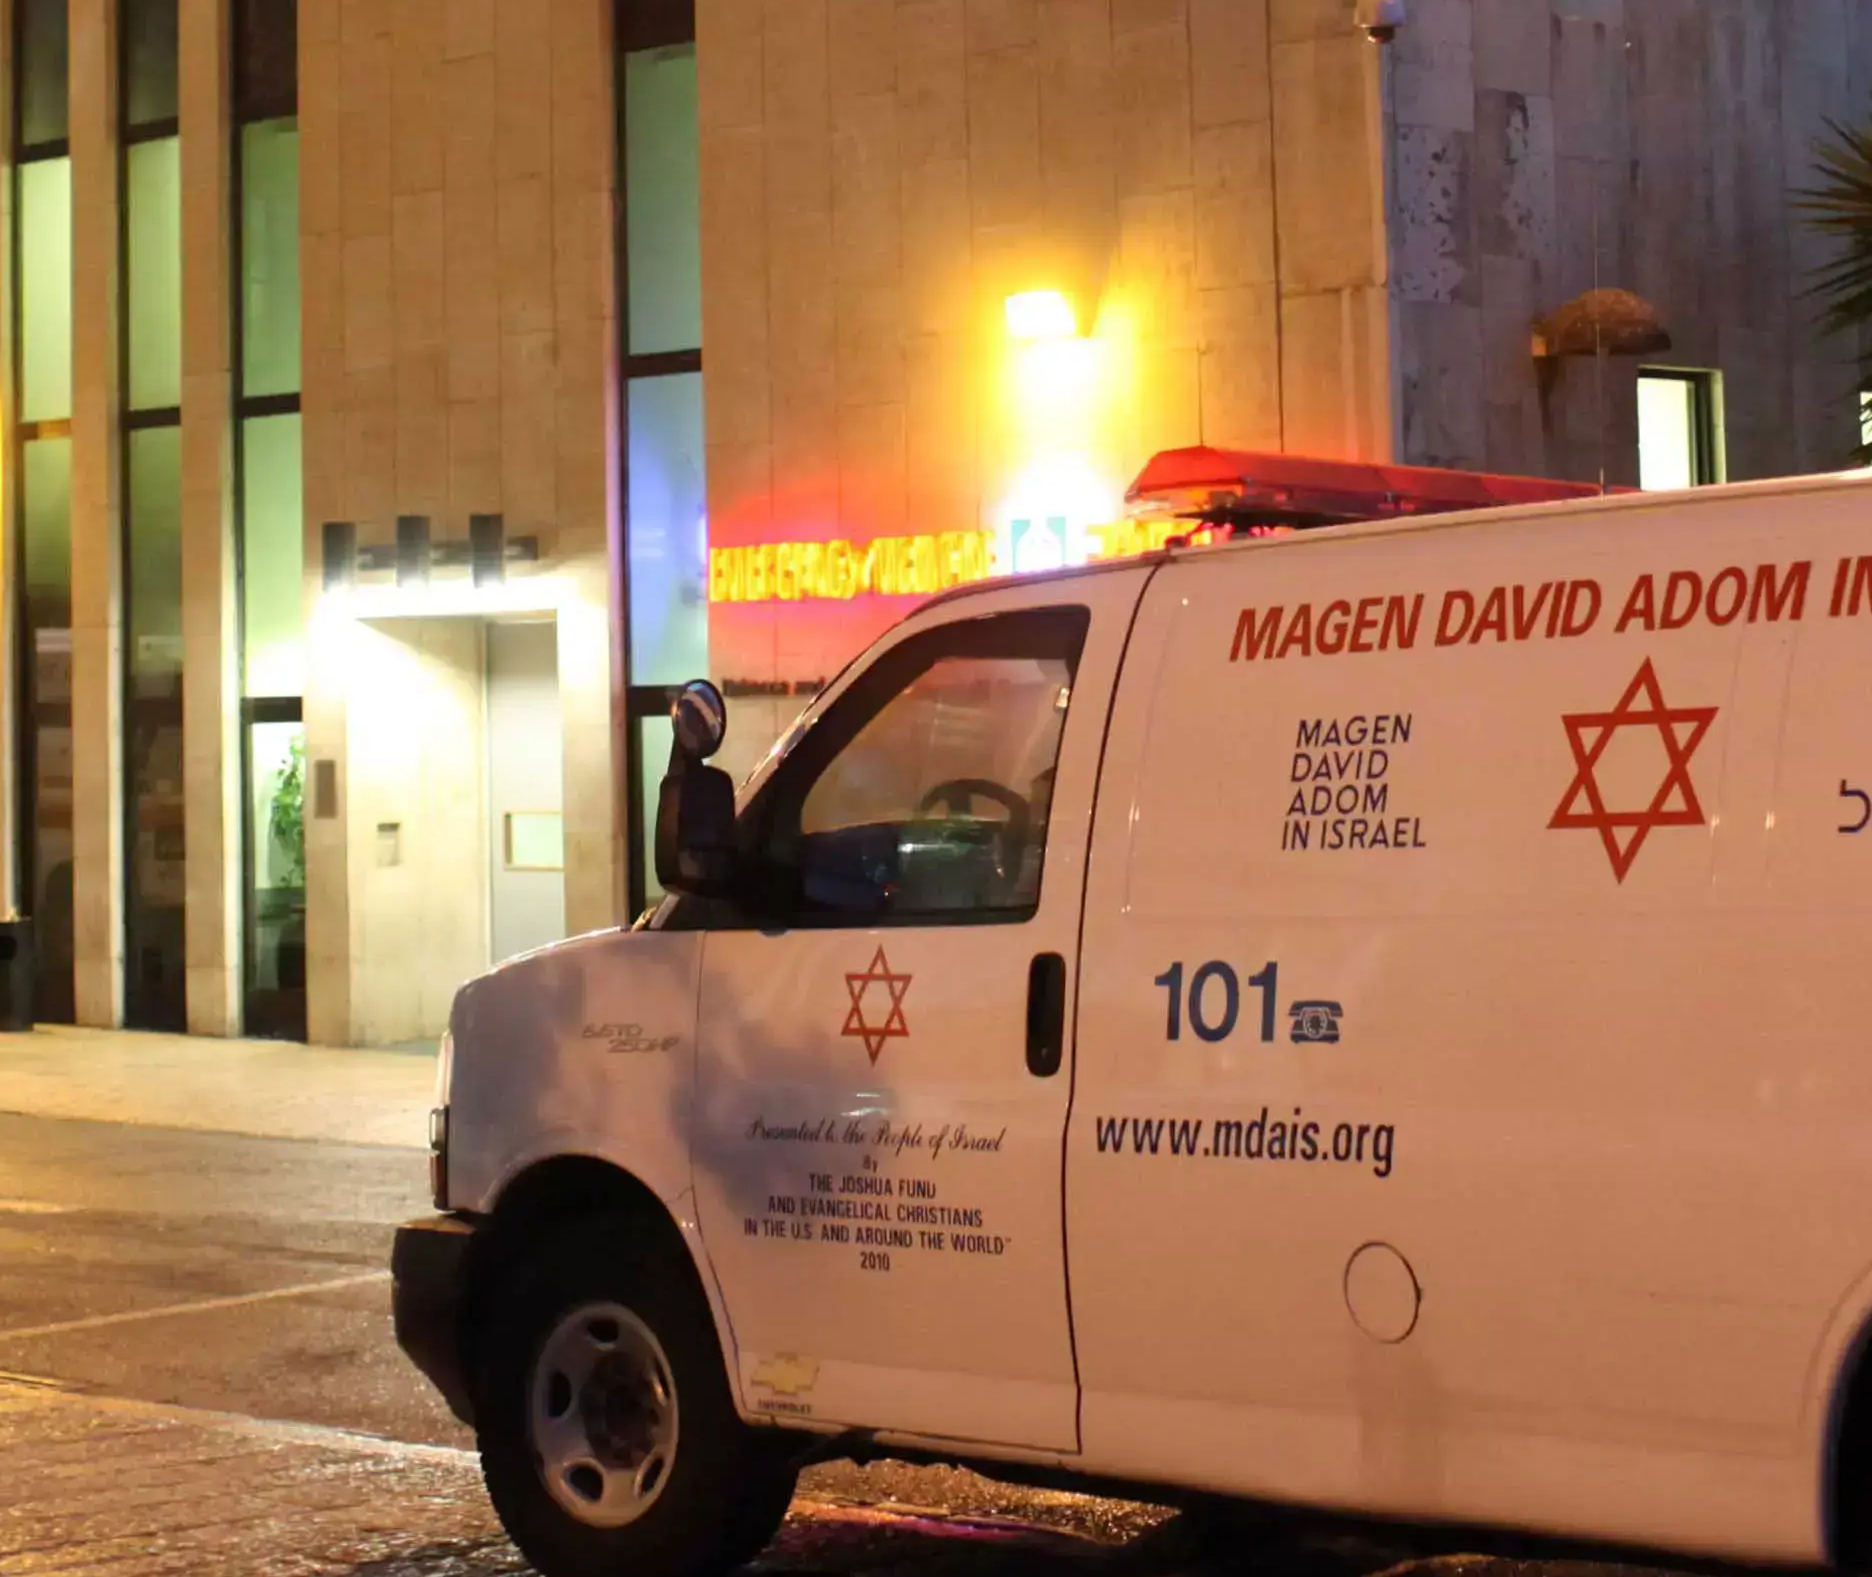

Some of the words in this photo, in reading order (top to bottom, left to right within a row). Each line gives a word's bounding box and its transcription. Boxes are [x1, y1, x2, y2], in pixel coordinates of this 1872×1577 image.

[1229, 593, 1424, 662] MAGEN
[1434, 578, 1602, 647] DAVID
[1613, 560, 1812, 632] ADOM
[1296, 713, 1412, 748] MAGEN
[1290, 749, 1389, 782] DAVID
[1286, 783, 1388, 816] ADOM
[1281, 820, 1310, 851] IN
[1320, 817, 1426, 850] ISRAEL
[1154, 960, 1278, 1042] 101
[843, 1120, 864, 1144] the
[872, 1120, 923, 1157] People
[929, 1124, 950, 1161] of
[948, 1123, 1006, 1152] Israel
[1096, 1106, 1395, 1178] www.mdais.org
[809, 1173, 833, 1193] THE
[839, 1175, 893, 1196] JOSHUA
[768, 1195, 796, 1215] AND
[801, 1197, 892, 1221] EVANGELICAL
[897, 1203, 983, 1228] CHRISTIANS
[744, 1217, 758, 1236] IN
[762, 1219, 786, 1238] THE
[821, 1223, 850, 1243] AND
[855, 1226, 913, 1249] AROUND
[918, 1230, 945, 1251] THE
[860, 1251, 891, 1272] 2010
